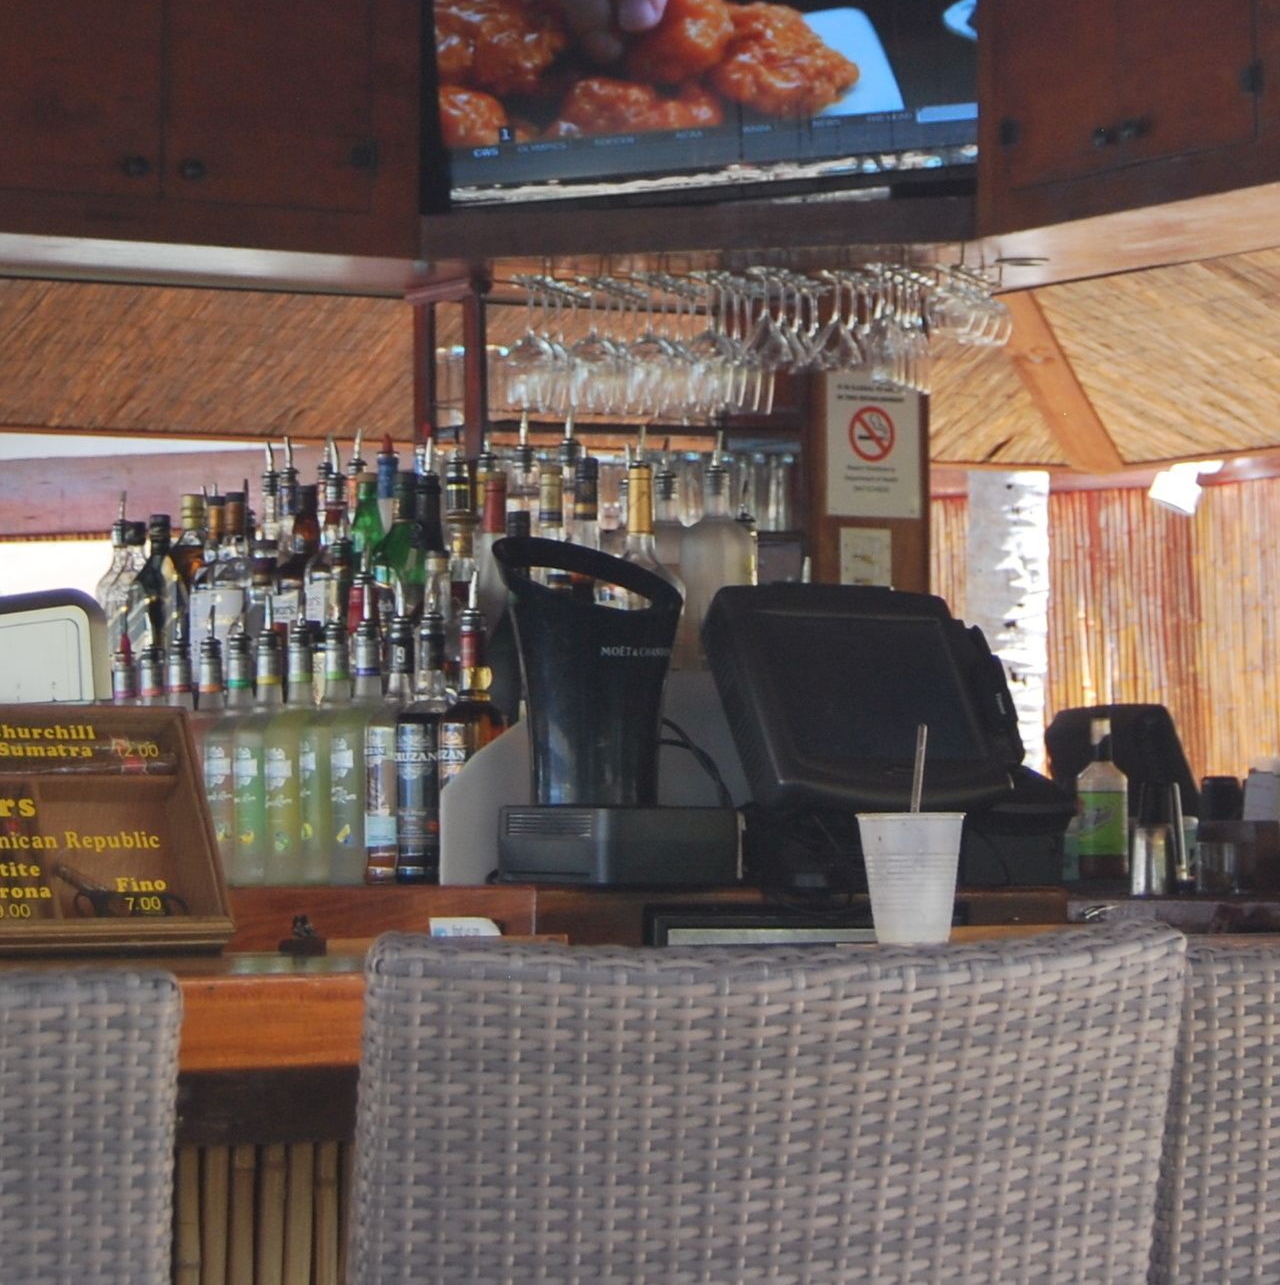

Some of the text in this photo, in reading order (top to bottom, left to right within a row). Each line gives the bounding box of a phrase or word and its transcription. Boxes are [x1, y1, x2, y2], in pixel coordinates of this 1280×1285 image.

[64, 830, 161, 852] Republic
[115, 877, 167, 892] Fino
[125, 895, 162, 911] 7.00
